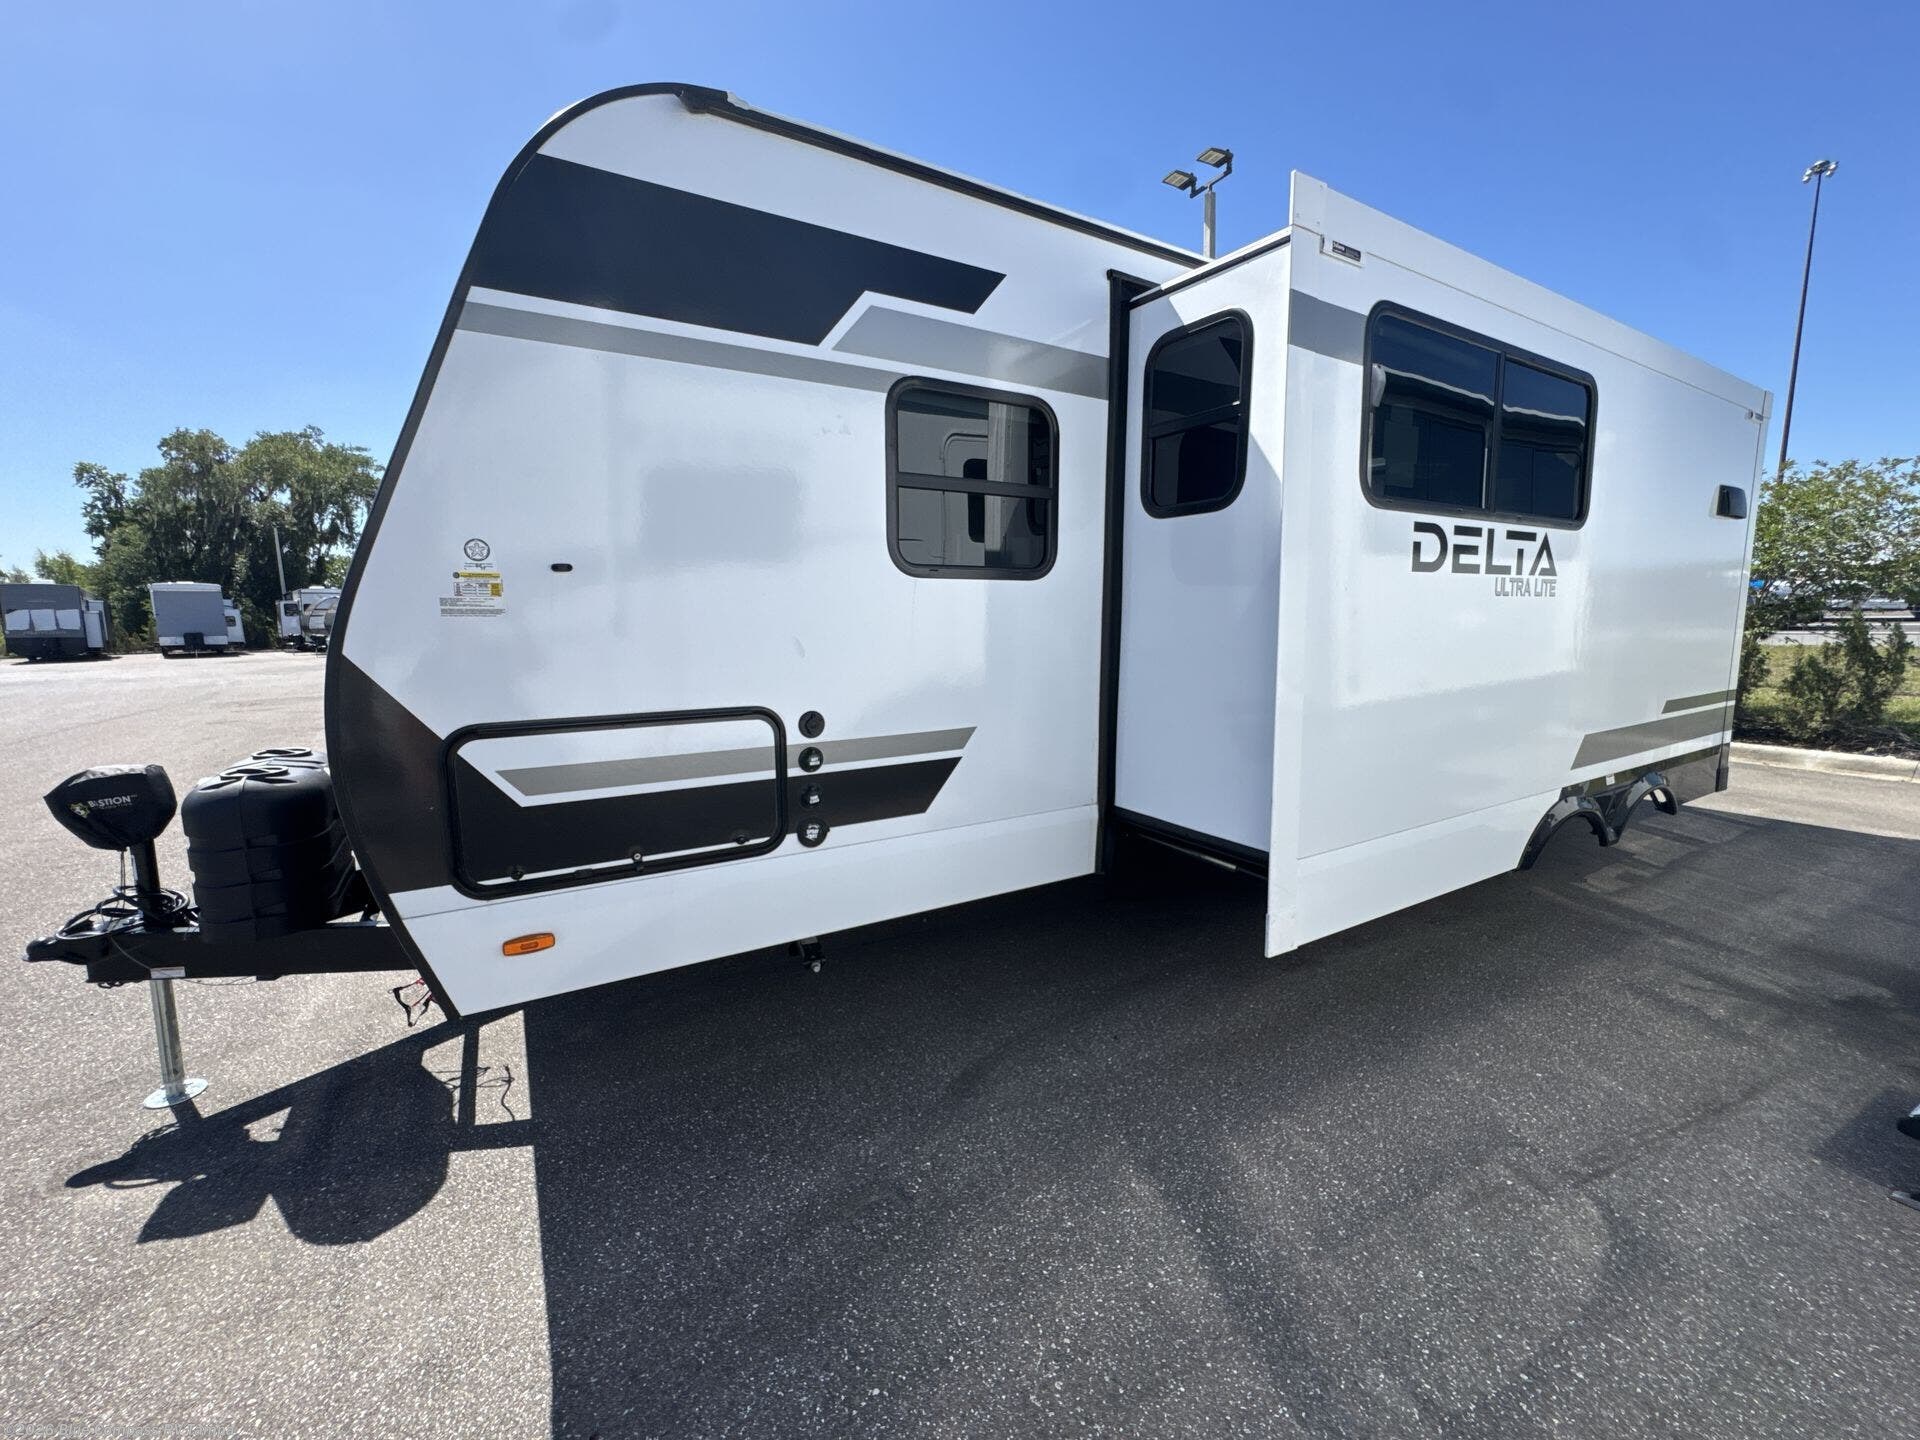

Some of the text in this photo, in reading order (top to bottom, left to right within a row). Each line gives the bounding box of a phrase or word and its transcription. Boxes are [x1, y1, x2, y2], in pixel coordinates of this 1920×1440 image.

[1411, 521, 1558, 577] DELTA
[1494, 577, 1557, 597] ULTRA LITE
